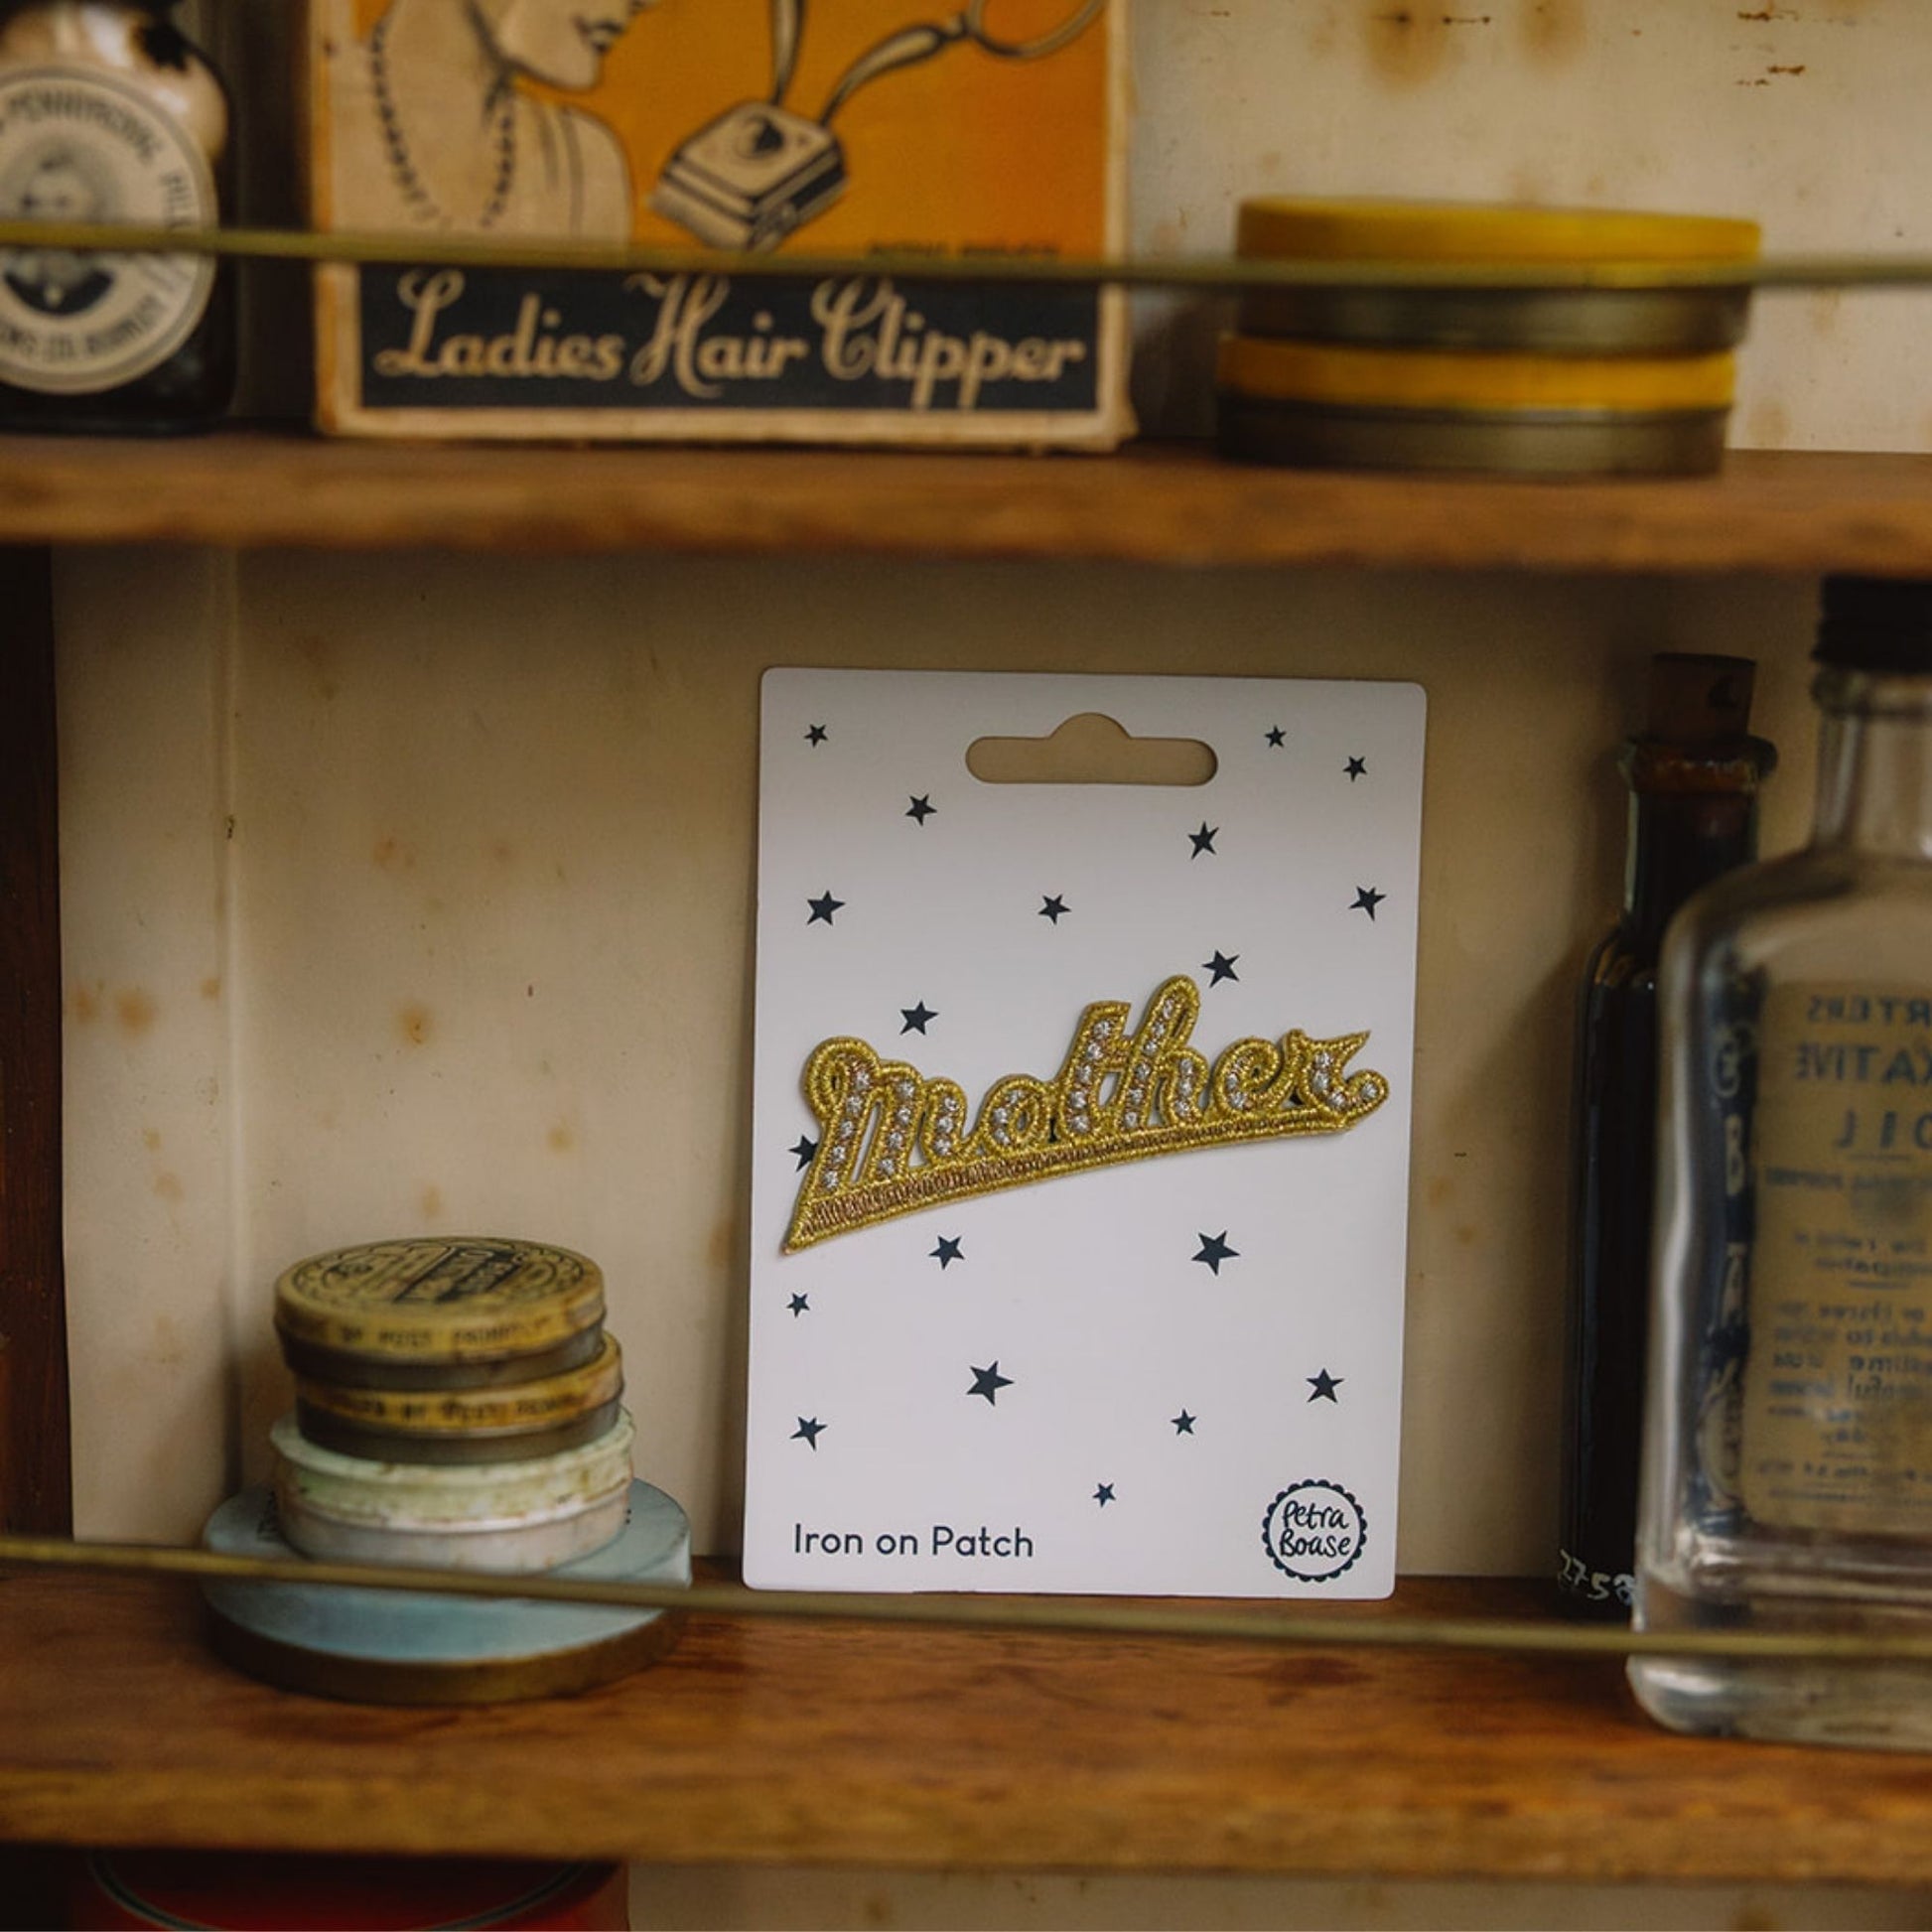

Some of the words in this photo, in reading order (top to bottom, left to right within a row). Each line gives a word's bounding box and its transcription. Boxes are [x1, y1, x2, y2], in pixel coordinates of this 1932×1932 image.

[373, 269, 625, 381] Ladies
[625, 272, 808, 397] Hair
[811, 277, 1086, 410] Clipper
[1282, 1499, 1350, 1530] Petra
[794, 1523, 864, 1555] Iron
[876, 1534, 918, 1556] on
[931, 1525, 1034, 1559] Patch
[1279, 1528, 1352, 1558] Boase
